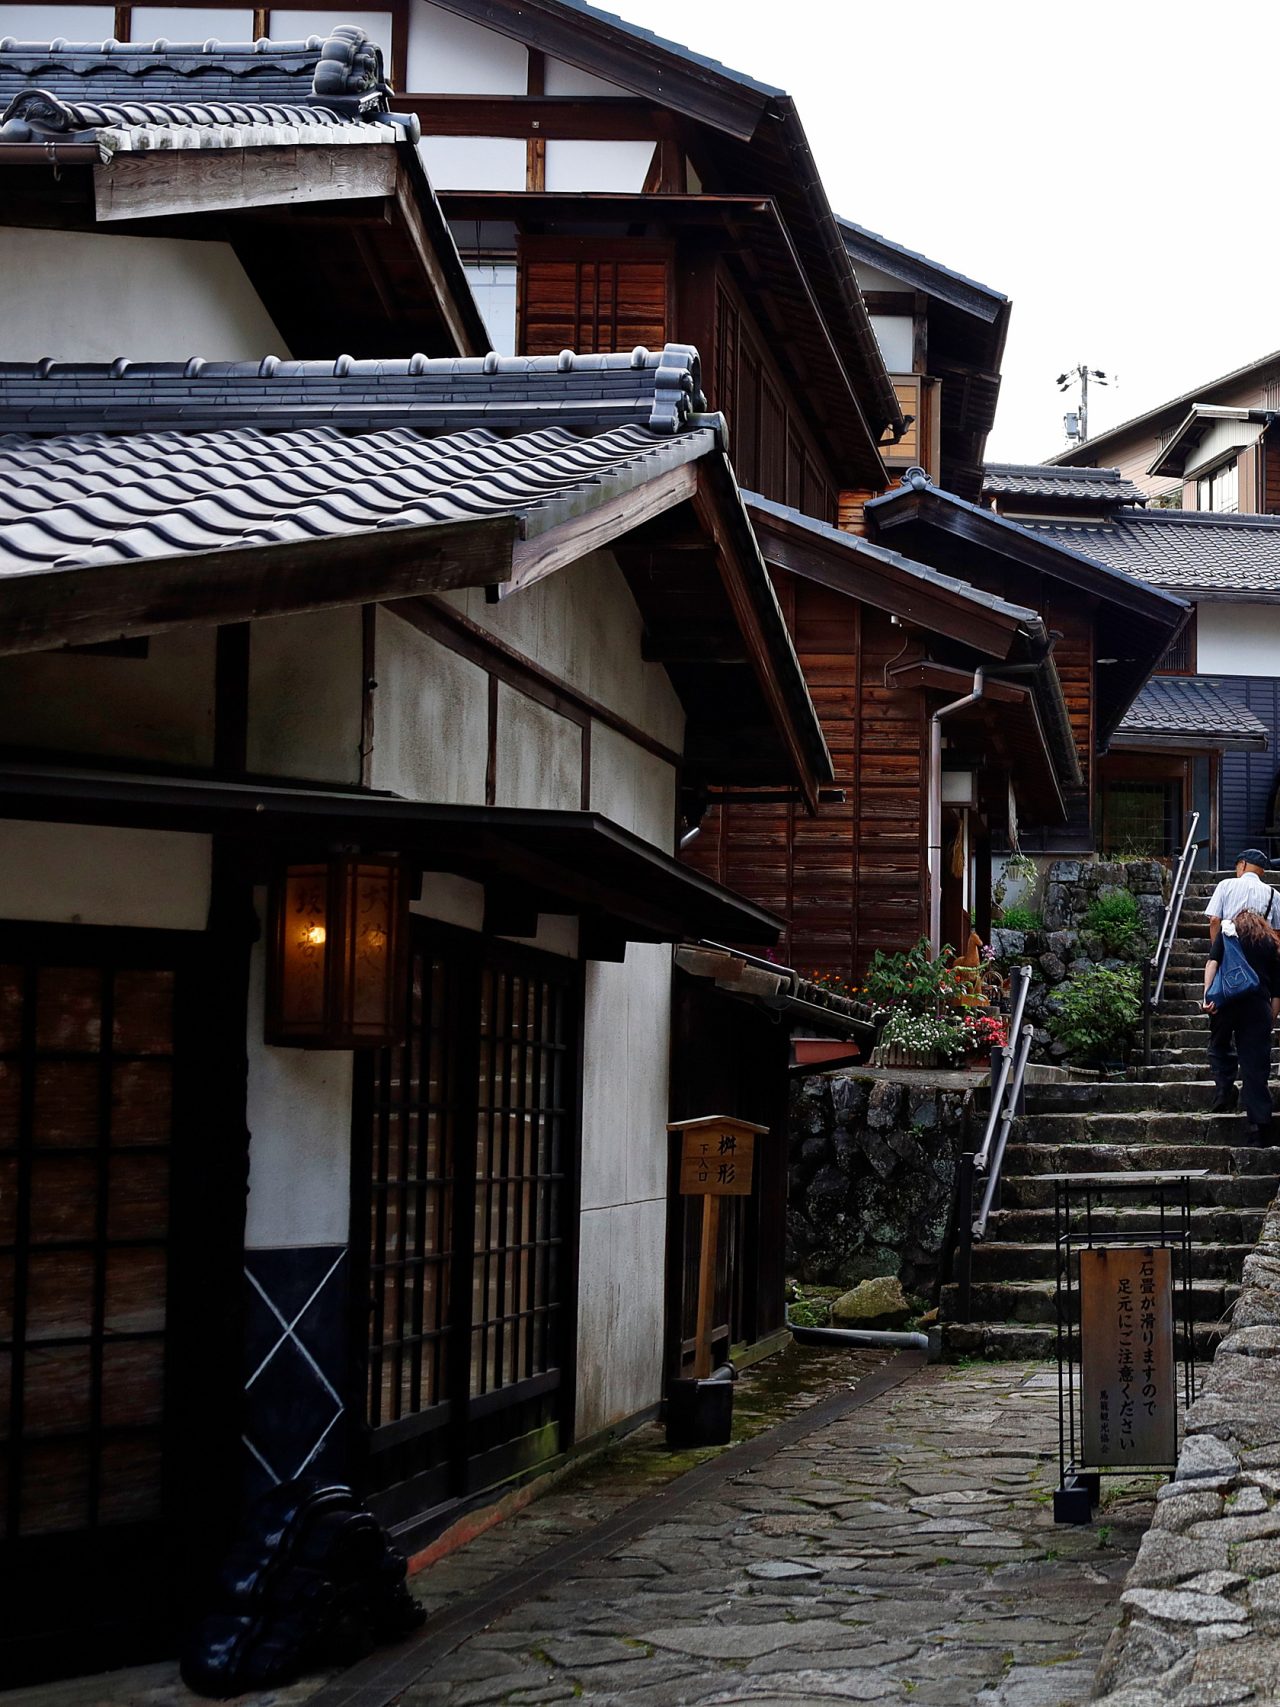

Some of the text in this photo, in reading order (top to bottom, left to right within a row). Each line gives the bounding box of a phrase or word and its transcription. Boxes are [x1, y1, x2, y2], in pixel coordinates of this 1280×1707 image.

[698, 1144, 710, 1182] 下入口
[1117, 1279, 1135, 1450] 足元にご注意ください
[1139, 1261, 1157, 1416] 石畳が滑りますので
